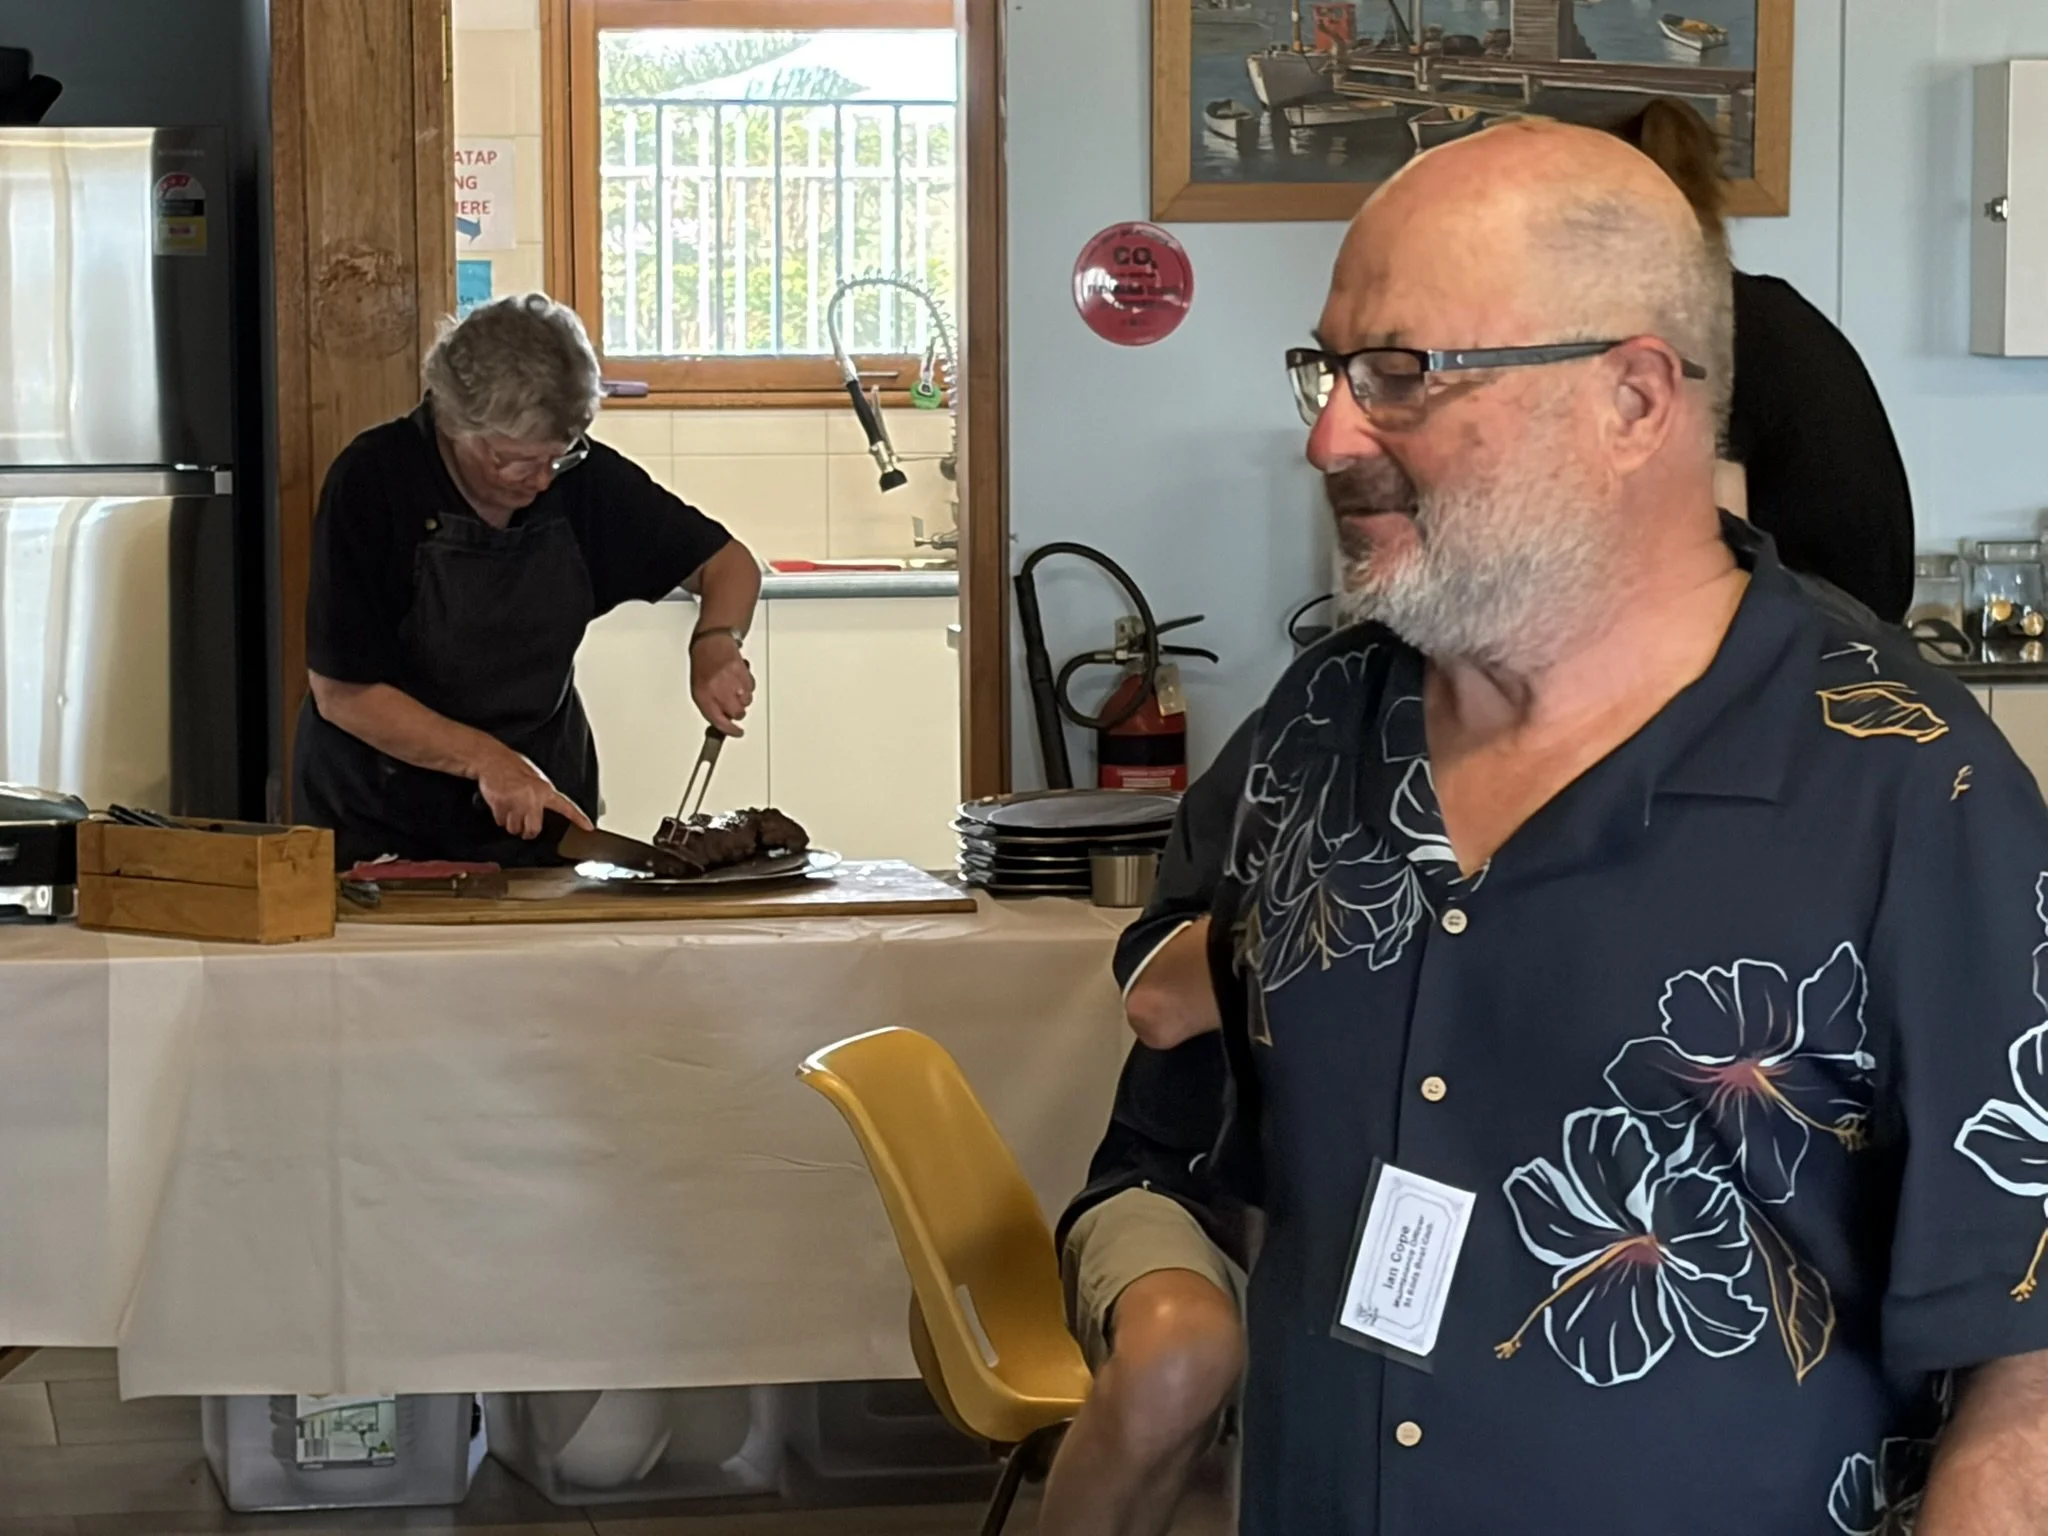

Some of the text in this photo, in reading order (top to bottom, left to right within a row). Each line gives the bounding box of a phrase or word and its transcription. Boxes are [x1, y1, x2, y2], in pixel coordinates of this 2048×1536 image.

[455, 200, 492, 215] ERE
[1382, 1225, 1410, 1290] Ian Cope
